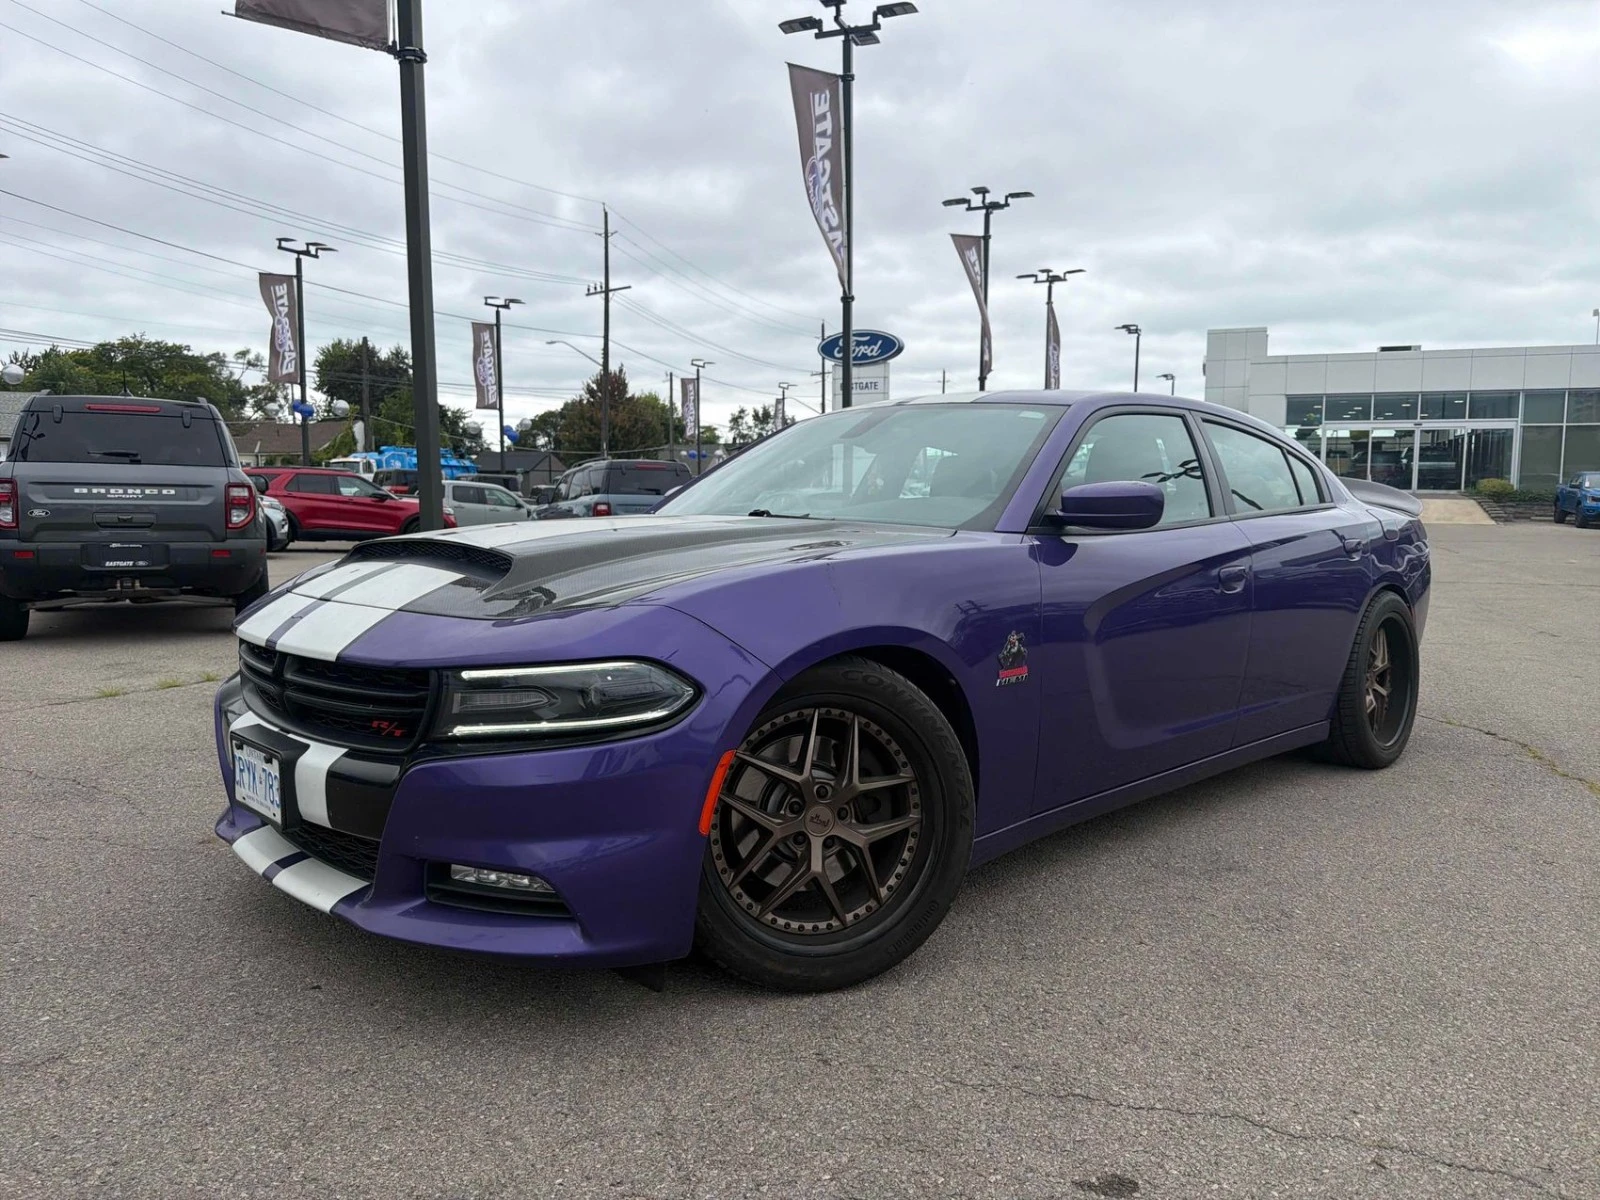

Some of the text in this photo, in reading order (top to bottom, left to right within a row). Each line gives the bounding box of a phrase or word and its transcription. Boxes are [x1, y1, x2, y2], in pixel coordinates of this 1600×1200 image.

[833, 336, 882, 358] Ford
[74, 487, 176, 495] BRONCO
[371, 720, 407, 737] R/T
